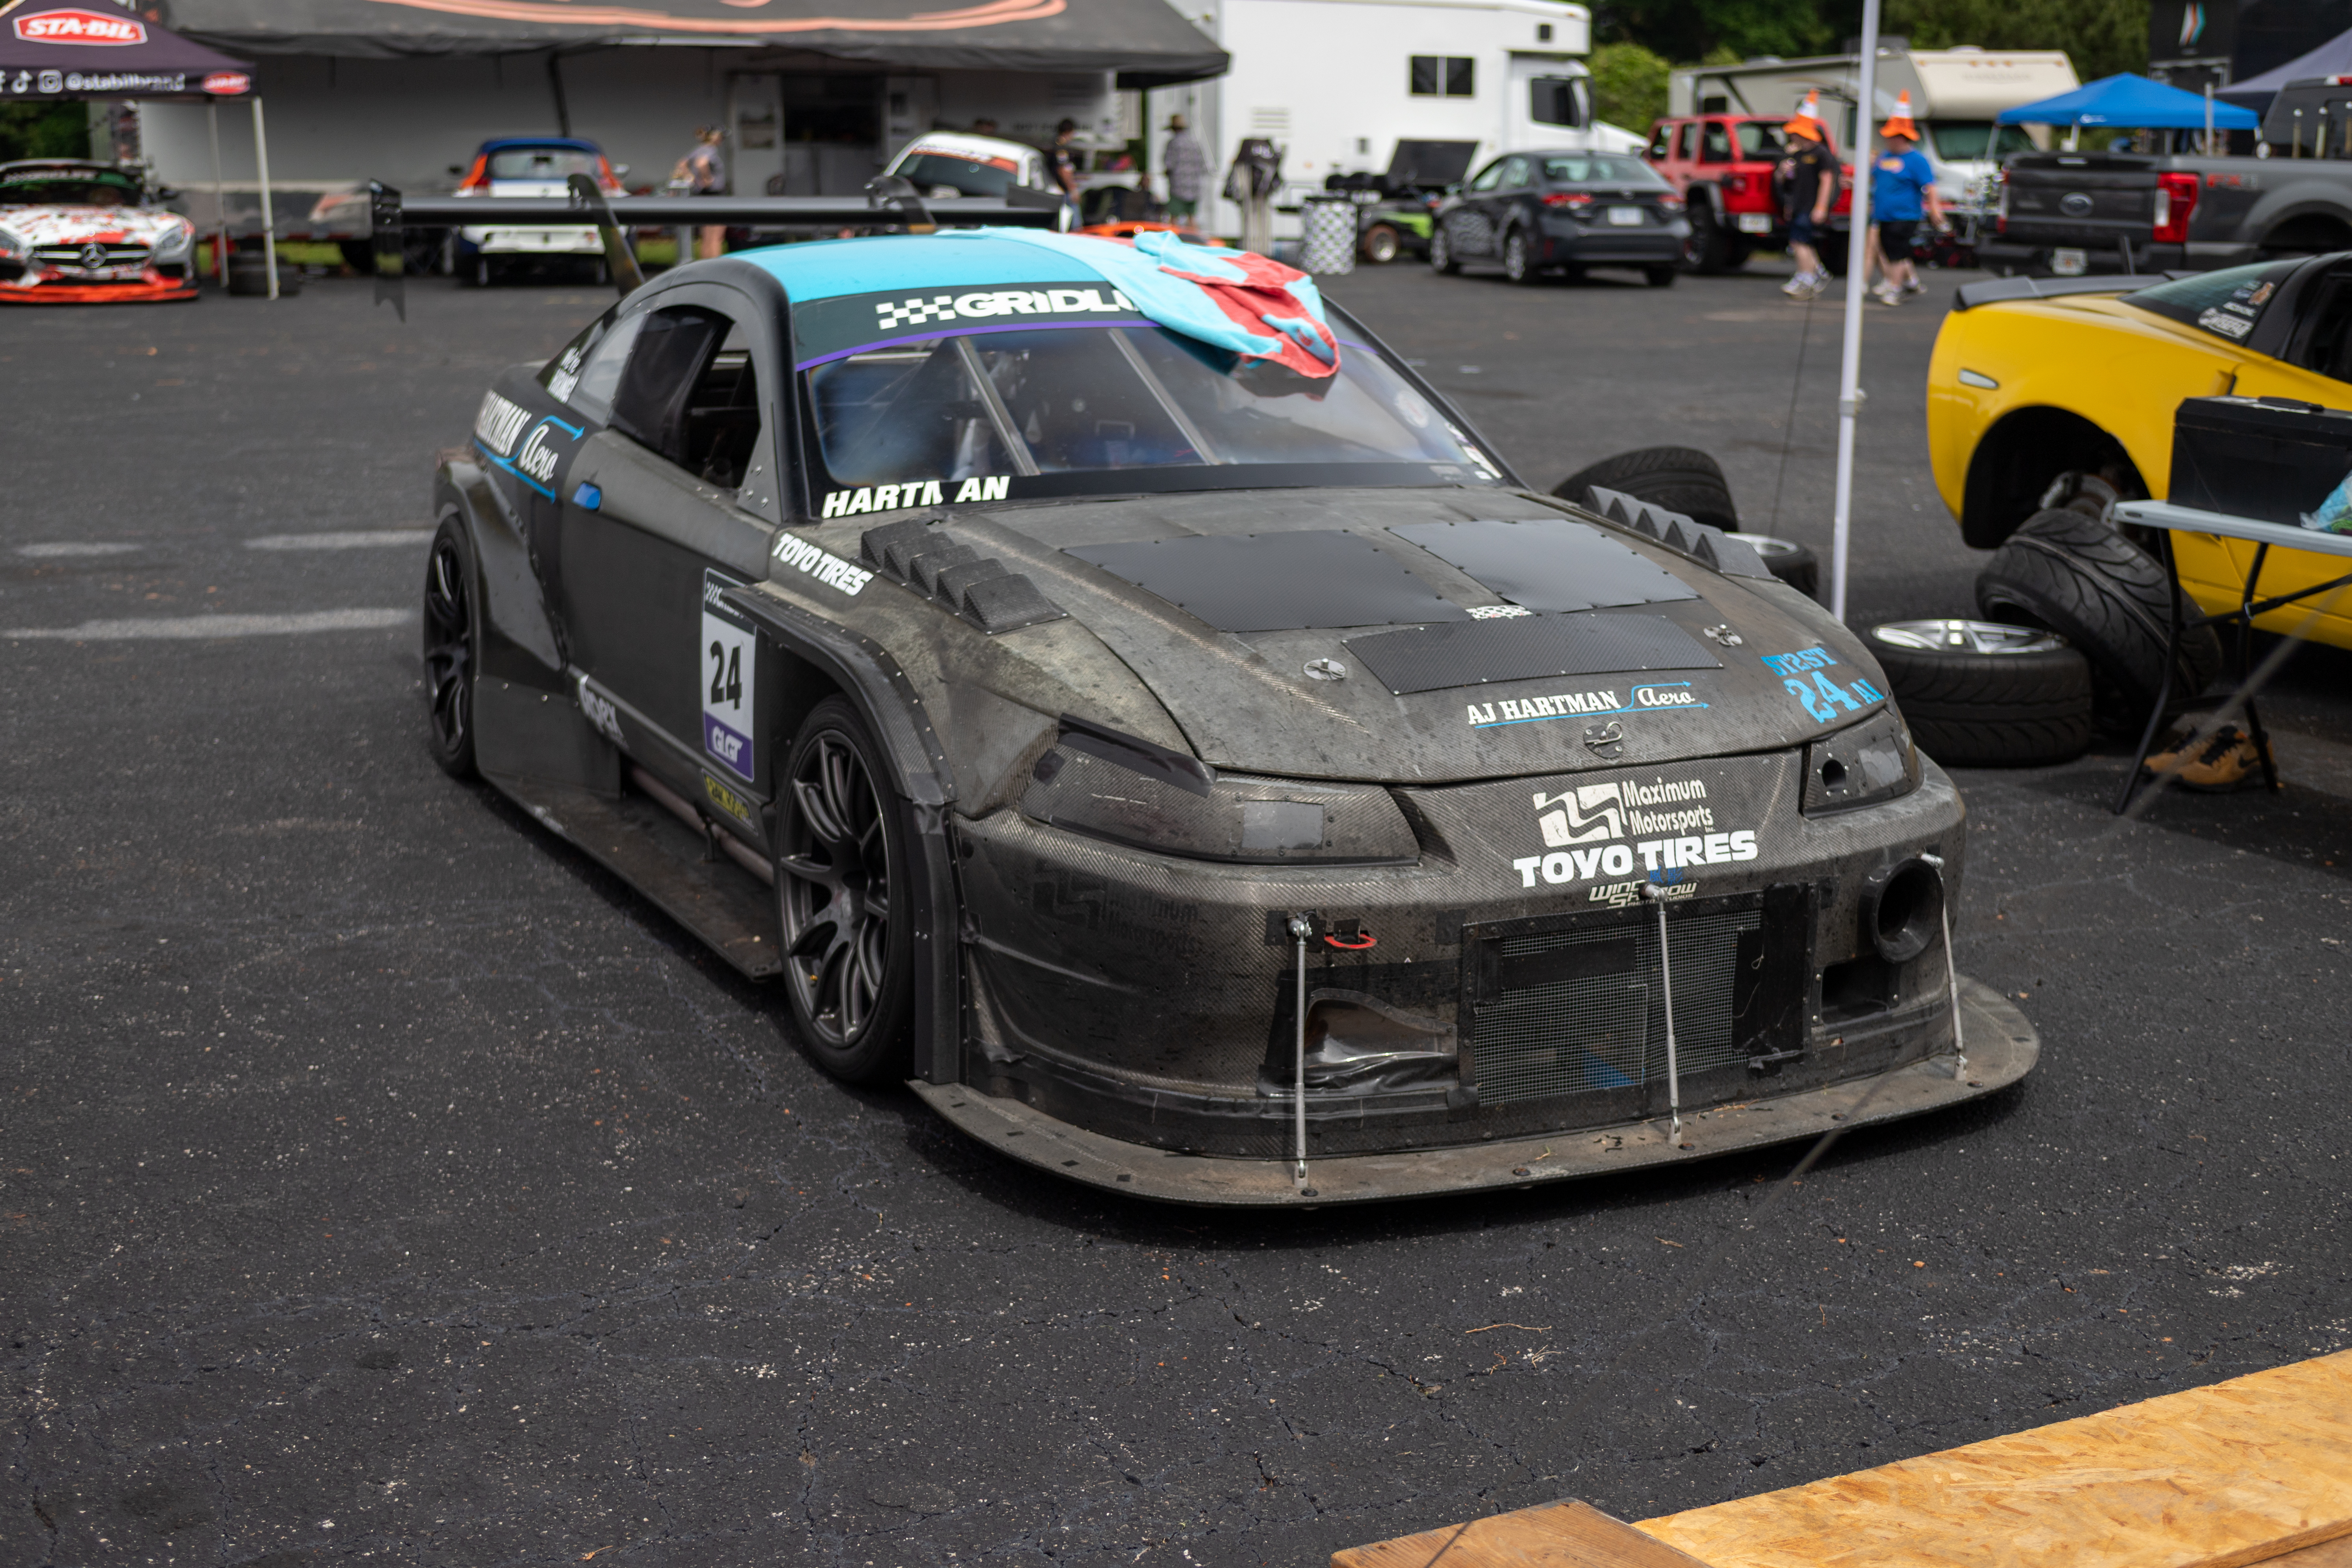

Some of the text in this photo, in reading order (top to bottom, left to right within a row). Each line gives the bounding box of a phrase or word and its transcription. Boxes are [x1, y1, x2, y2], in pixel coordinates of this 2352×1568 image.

[953, 289, 1139, 317] GRIDLI
[771, 532, 875, 597] TOYO TIRES
[710, 640, 742, 710] 24
[1783, 670, 1862, 724] 24
[1468, 688, 1695, 725] AJ HARTMAN Aero
[1622, 777, 1707, 808] Maximum
[1629, 805, 1714, 836] Motorsports
[1513, 830, 1759, 888] TOYO TIRES
